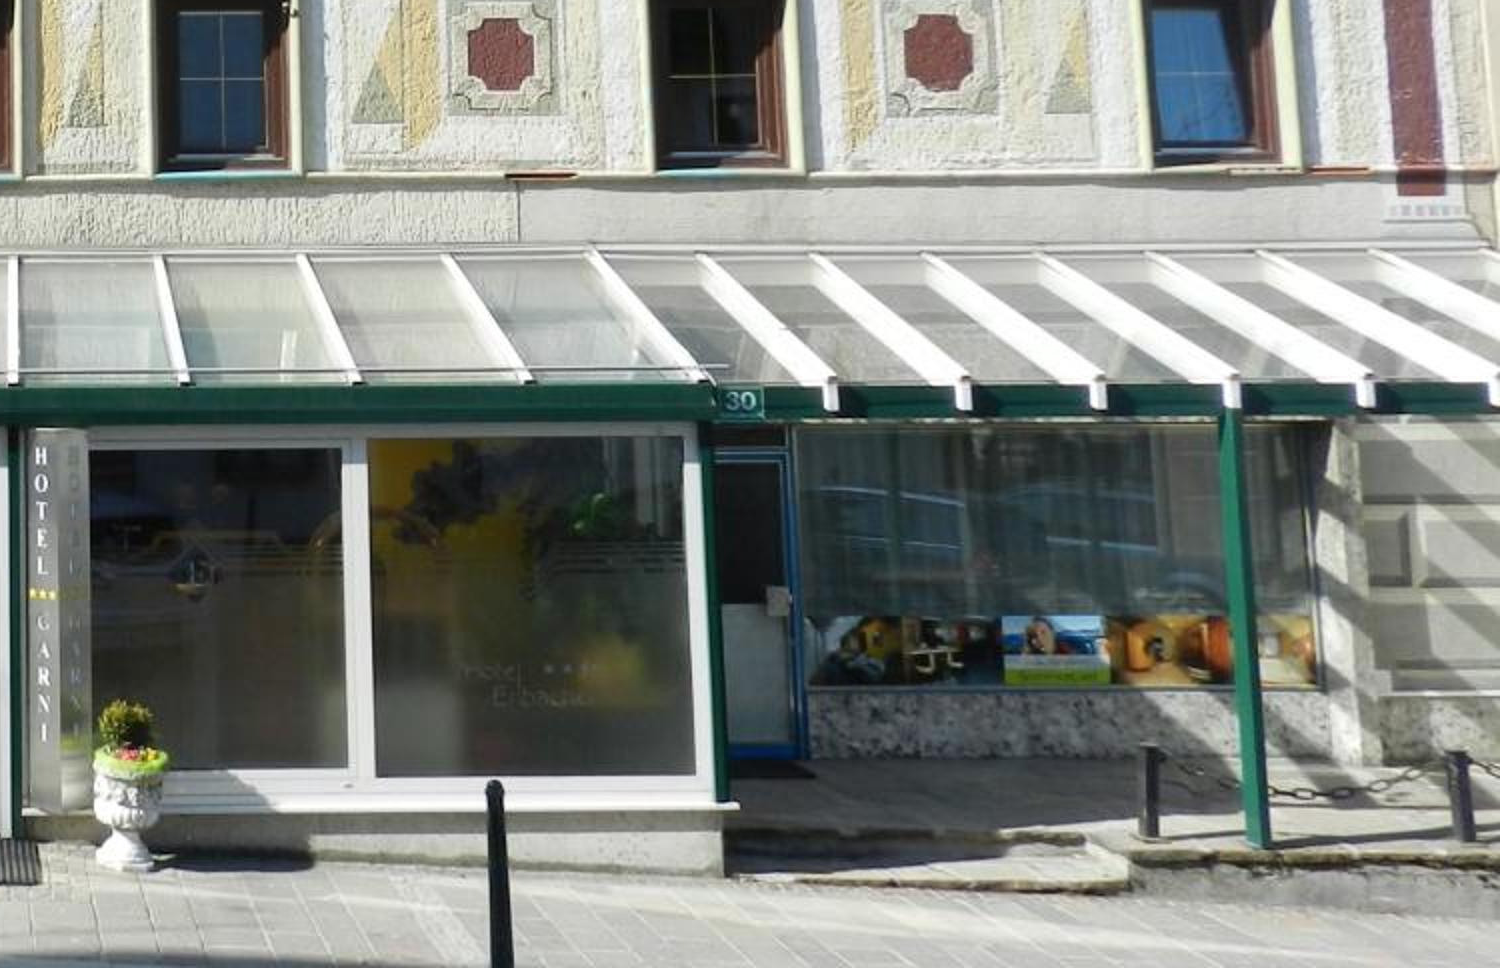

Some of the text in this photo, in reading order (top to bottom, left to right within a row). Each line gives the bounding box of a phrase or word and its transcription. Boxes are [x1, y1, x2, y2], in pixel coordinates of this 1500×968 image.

[725, 390, 757, 411] 30
[33, 445, 52, 743] HOTEL GARNI
